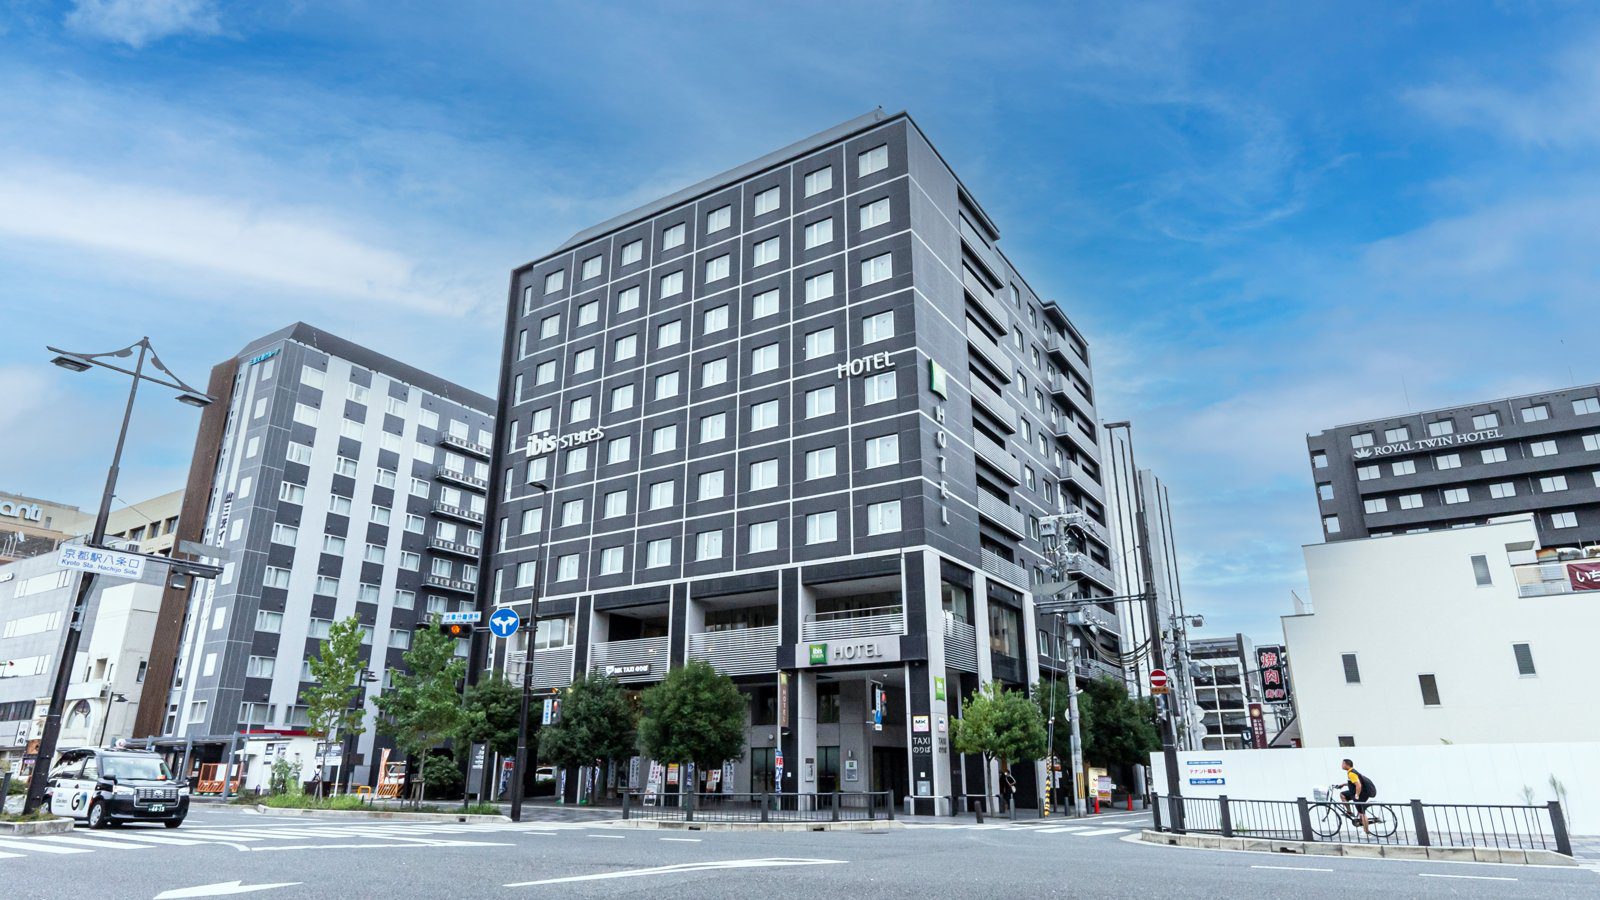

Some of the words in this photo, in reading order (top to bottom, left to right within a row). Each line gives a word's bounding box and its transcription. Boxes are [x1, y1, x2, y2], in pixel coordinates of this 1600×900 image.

[837, 350, 895, 379] HOTEL
[526, 431, 557, 457] ibis
[1374, 442, 1415, 456] ROYAL
[1415, 436, 1456, 449] TWIN
[1457, 429, 1503, 444] HOTEL
[935, 405, 950, 525] HOTEL
[61, 559, 80, 567] Kyoto
[64, 548, 140, 568] 京都駅八条口
[833, 643, 882, 660] HOTEL
[1260, 652, 1280, 685] 焼肉
[913, 737, 931, 745] TAXI
[913, 746, 931, 754] のりば
